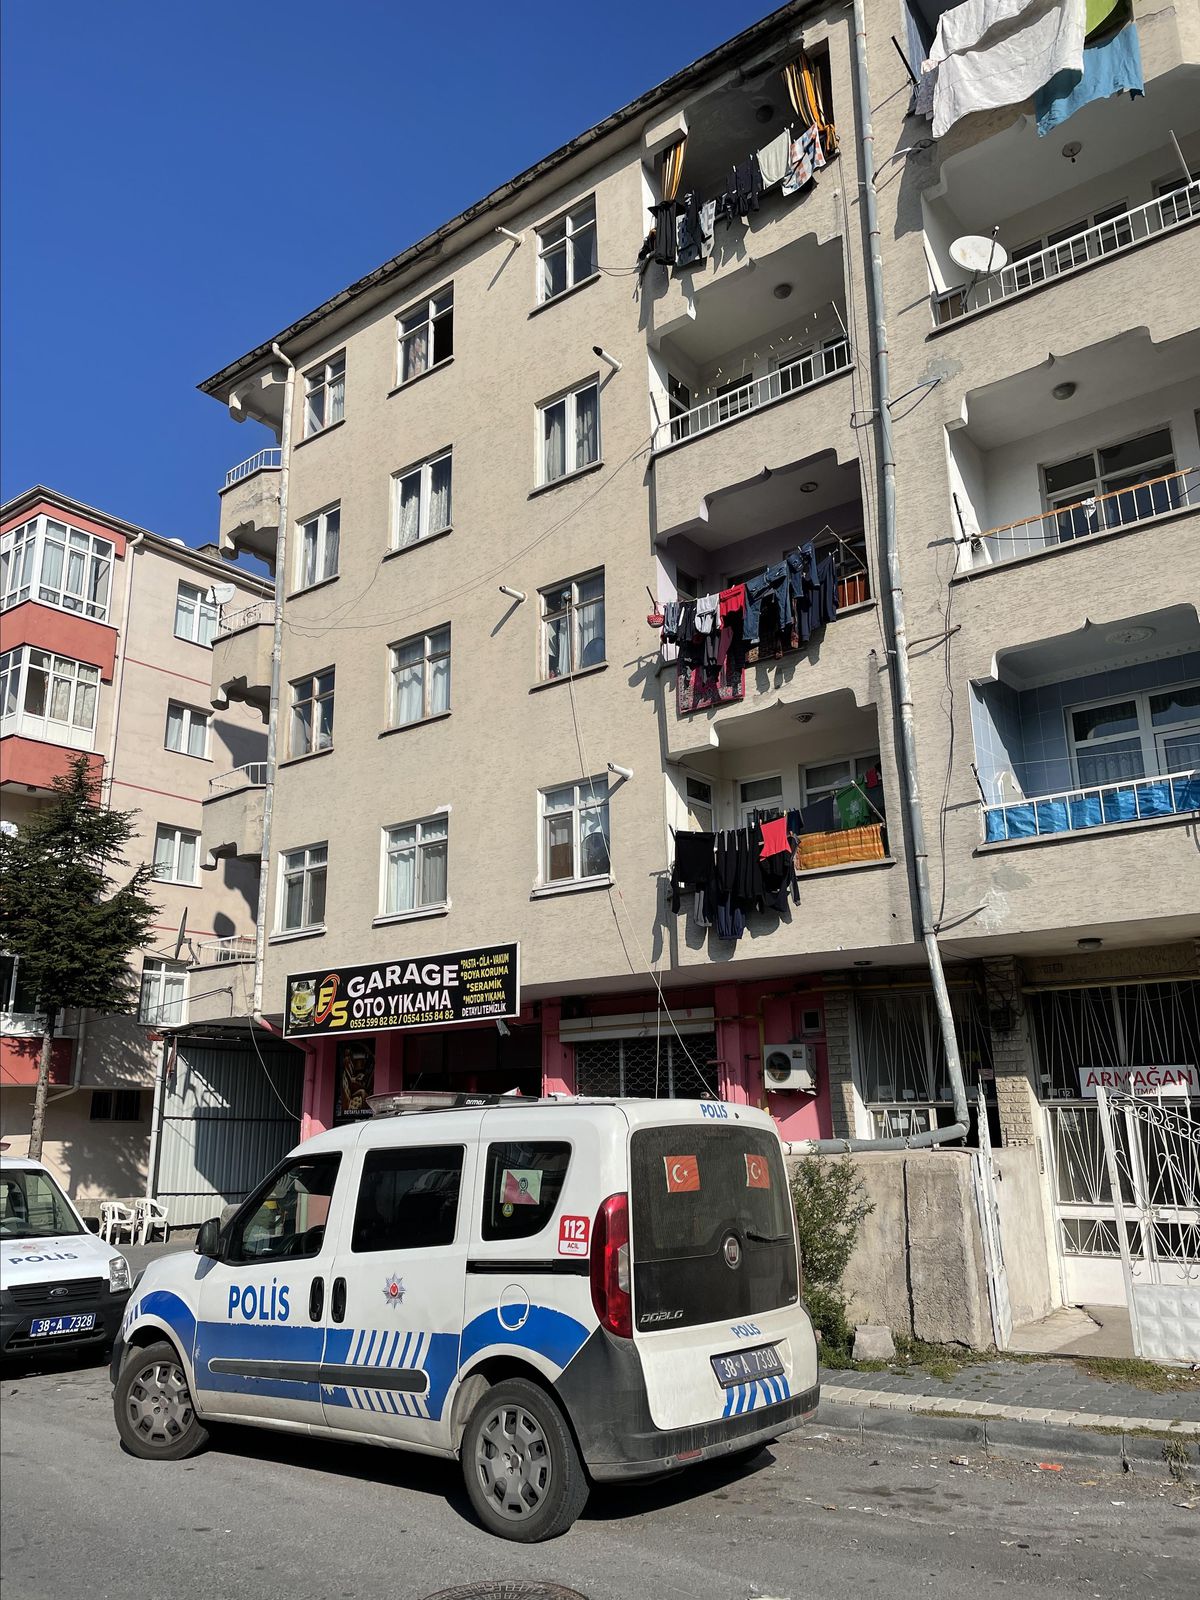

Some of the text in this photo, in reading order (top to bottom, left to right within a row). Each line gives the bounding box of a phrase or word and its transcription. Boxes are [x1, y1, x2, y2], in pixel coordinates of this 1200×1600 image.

[493, 953, 509, 964] VAKUM
[347, 963, 459, 998] GARAGE
[481, 965, 509, 978] KORUMA
[352, 996, 385, 1018] OTO
[350, 1018, 366, 1029] 0552
[366, 1017, 379, 1027] 599
[379, 1016, 388, 1026] 82
[389, 1015, 398, 1025] 82
[403, 1013, 420, 1024] 0554
[421, 1012, 433, 1022] 155
[434, 1010, 443, 1020] 84
[445, 1009, 454, 1019] 82
[1086, 1066, 1193, 1087] ARMAĞAN
[700, 1102, 728, 1118] POLİS
[563, 1219, 586, 1239] 112
[8, 1252, 79, 1264] POLİS
[228, 1277, 290, 1321] POLİS
[37, 1315, 93, 1332] 38 A 7328
[730, 1322, 761, 1338] POLİS
[721, 1349, 778, 1378] 38 A 7330
